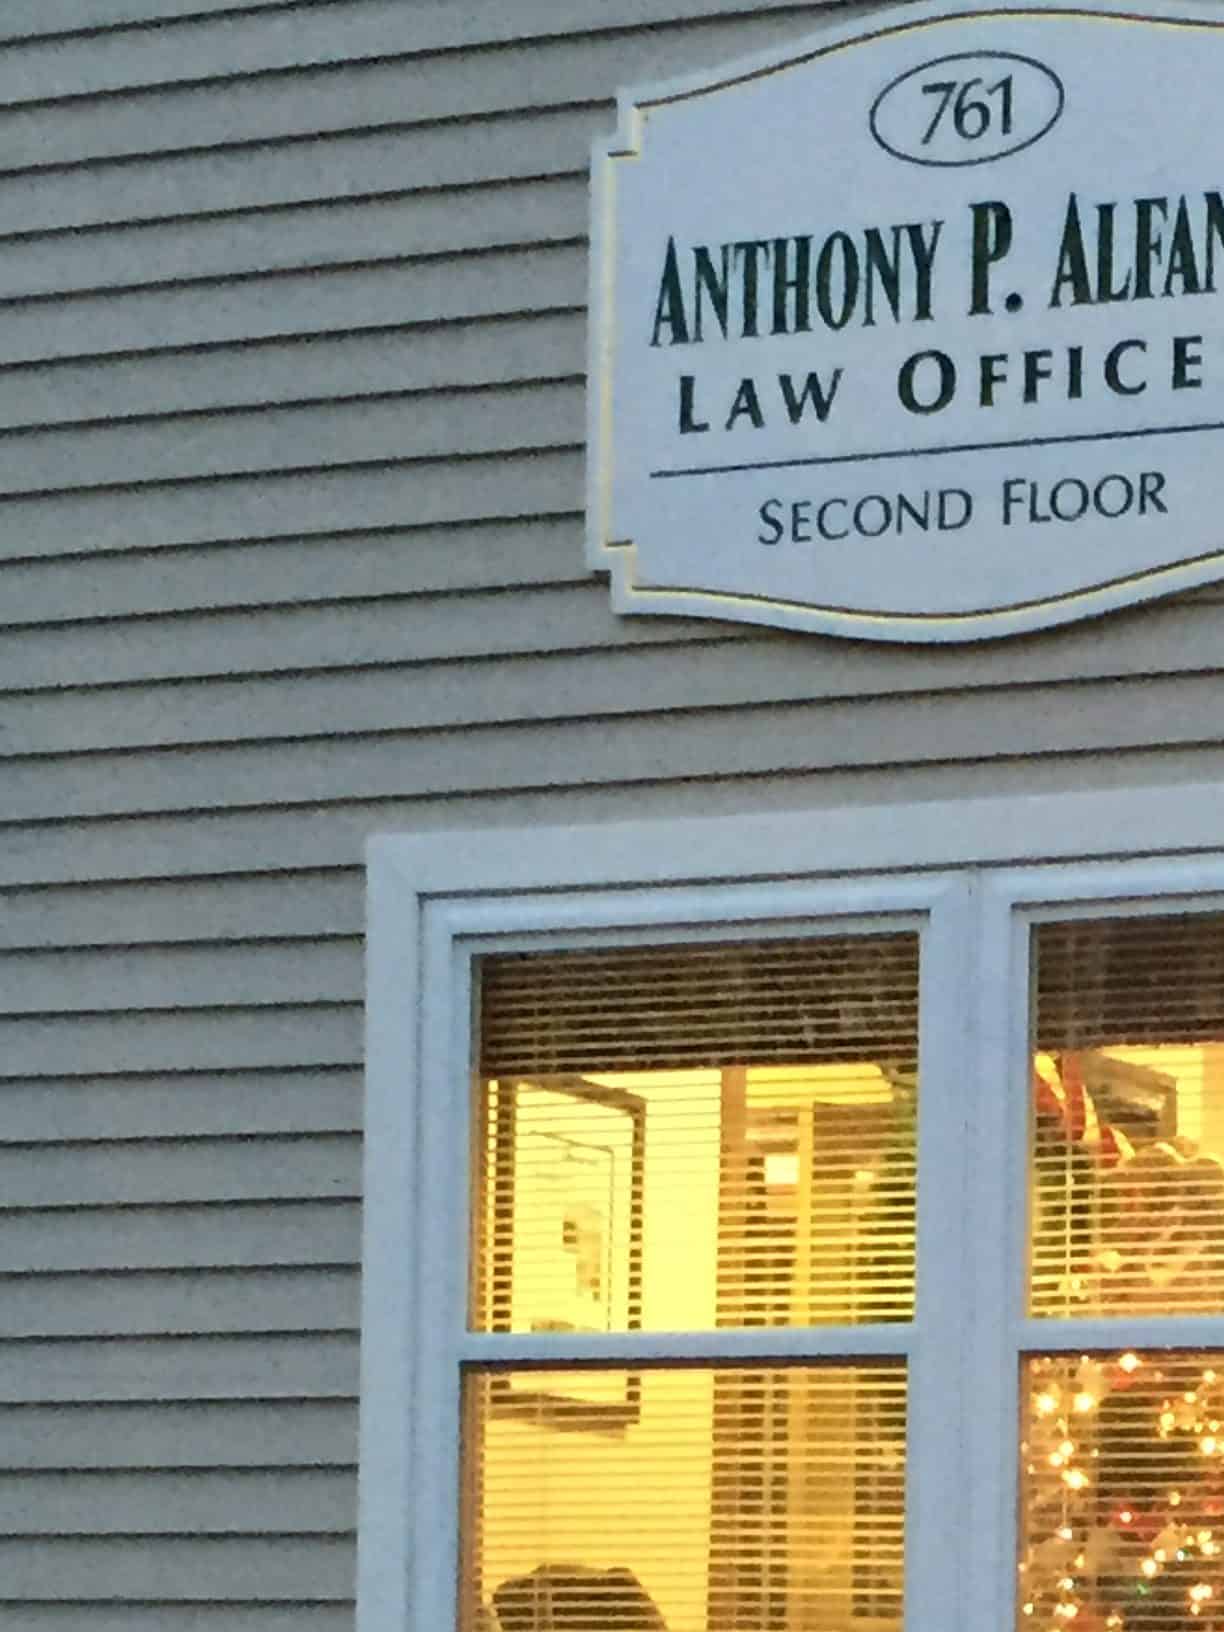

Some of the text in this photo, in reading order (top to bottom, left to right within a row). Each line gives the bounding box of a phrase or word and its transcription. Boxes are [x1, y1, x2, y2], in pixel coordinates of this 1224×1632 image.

[919, 74, 1015, 147] 761
[649, 220, 947, 347] ANTHONY
[968, 200, 1023, 316] P.
[679, 368, 843, 435] LAW
[758, 471, 1168, 545] SECOND FLOOR
